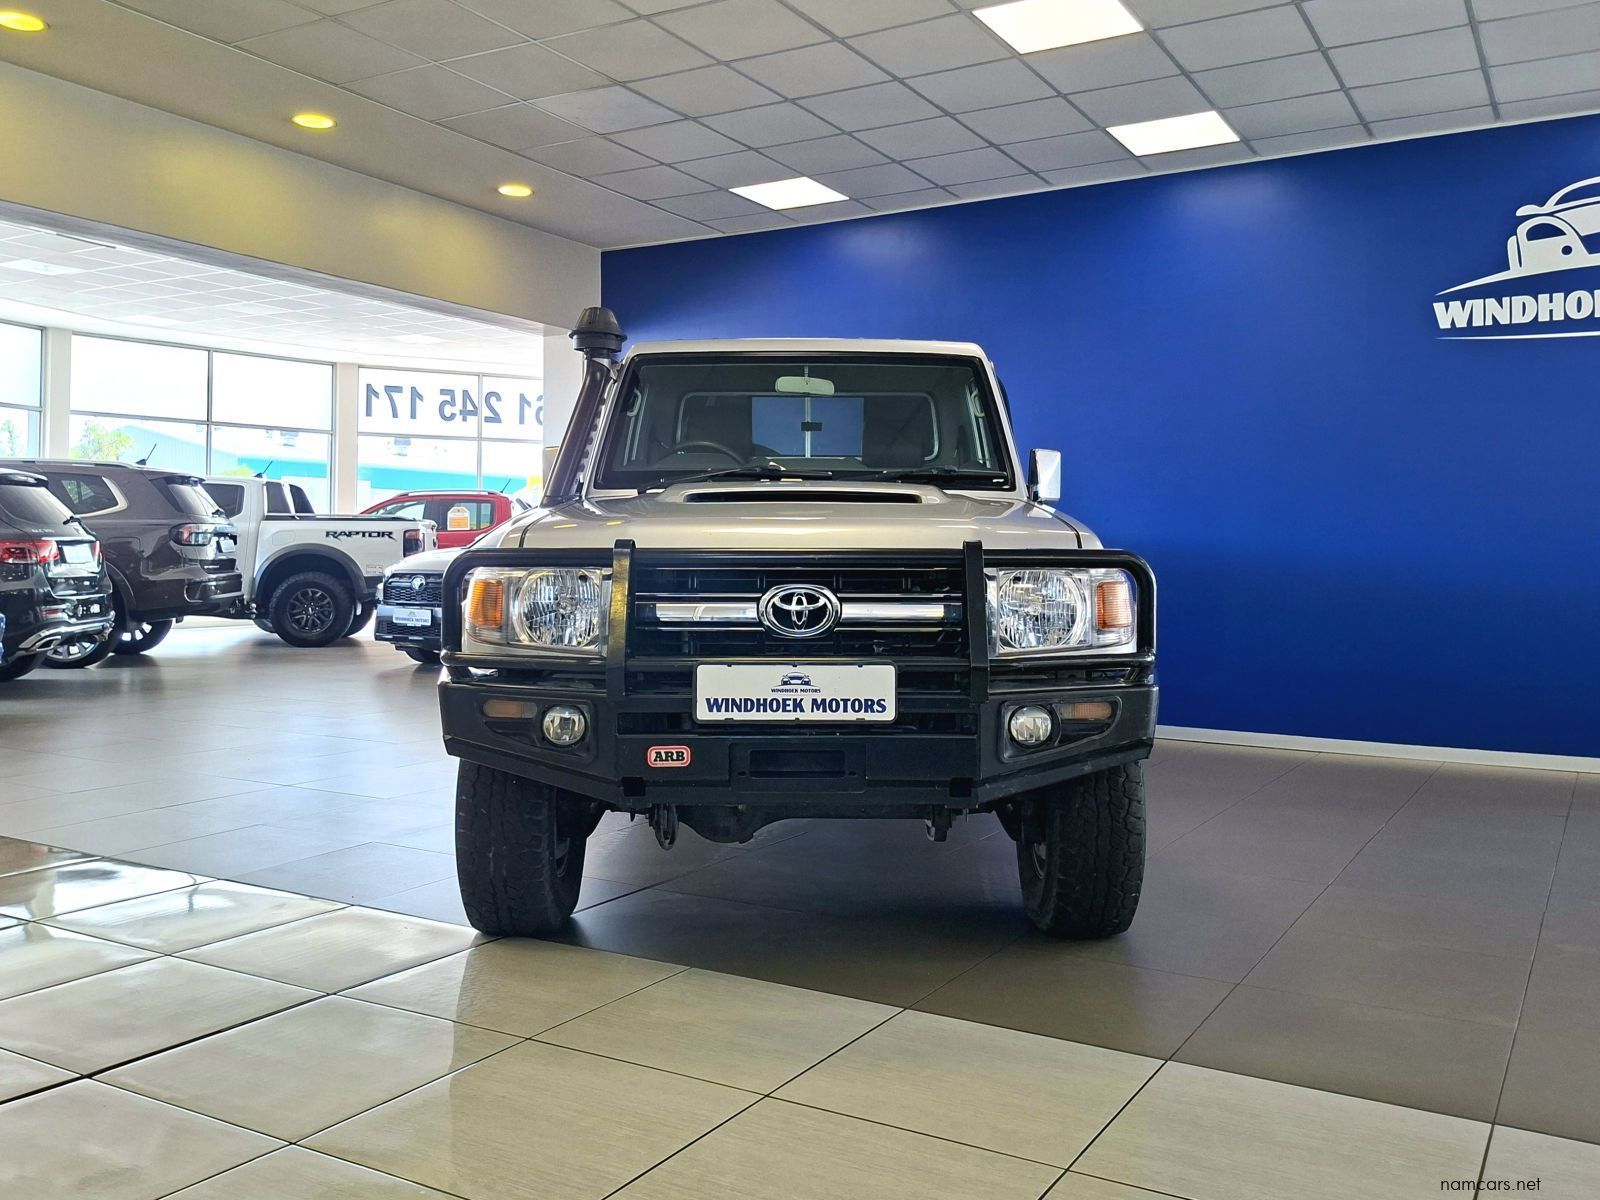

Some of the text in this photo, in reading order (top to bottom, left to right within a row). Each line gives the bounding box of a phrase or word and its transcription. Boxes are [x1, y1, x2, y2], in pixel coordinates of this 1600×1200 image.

[325, 530, 398, 542] RAPTOR
[705, 697, 887, 713] WINDHOEK MOTORS
[653, 750, 686, 762] ARB
